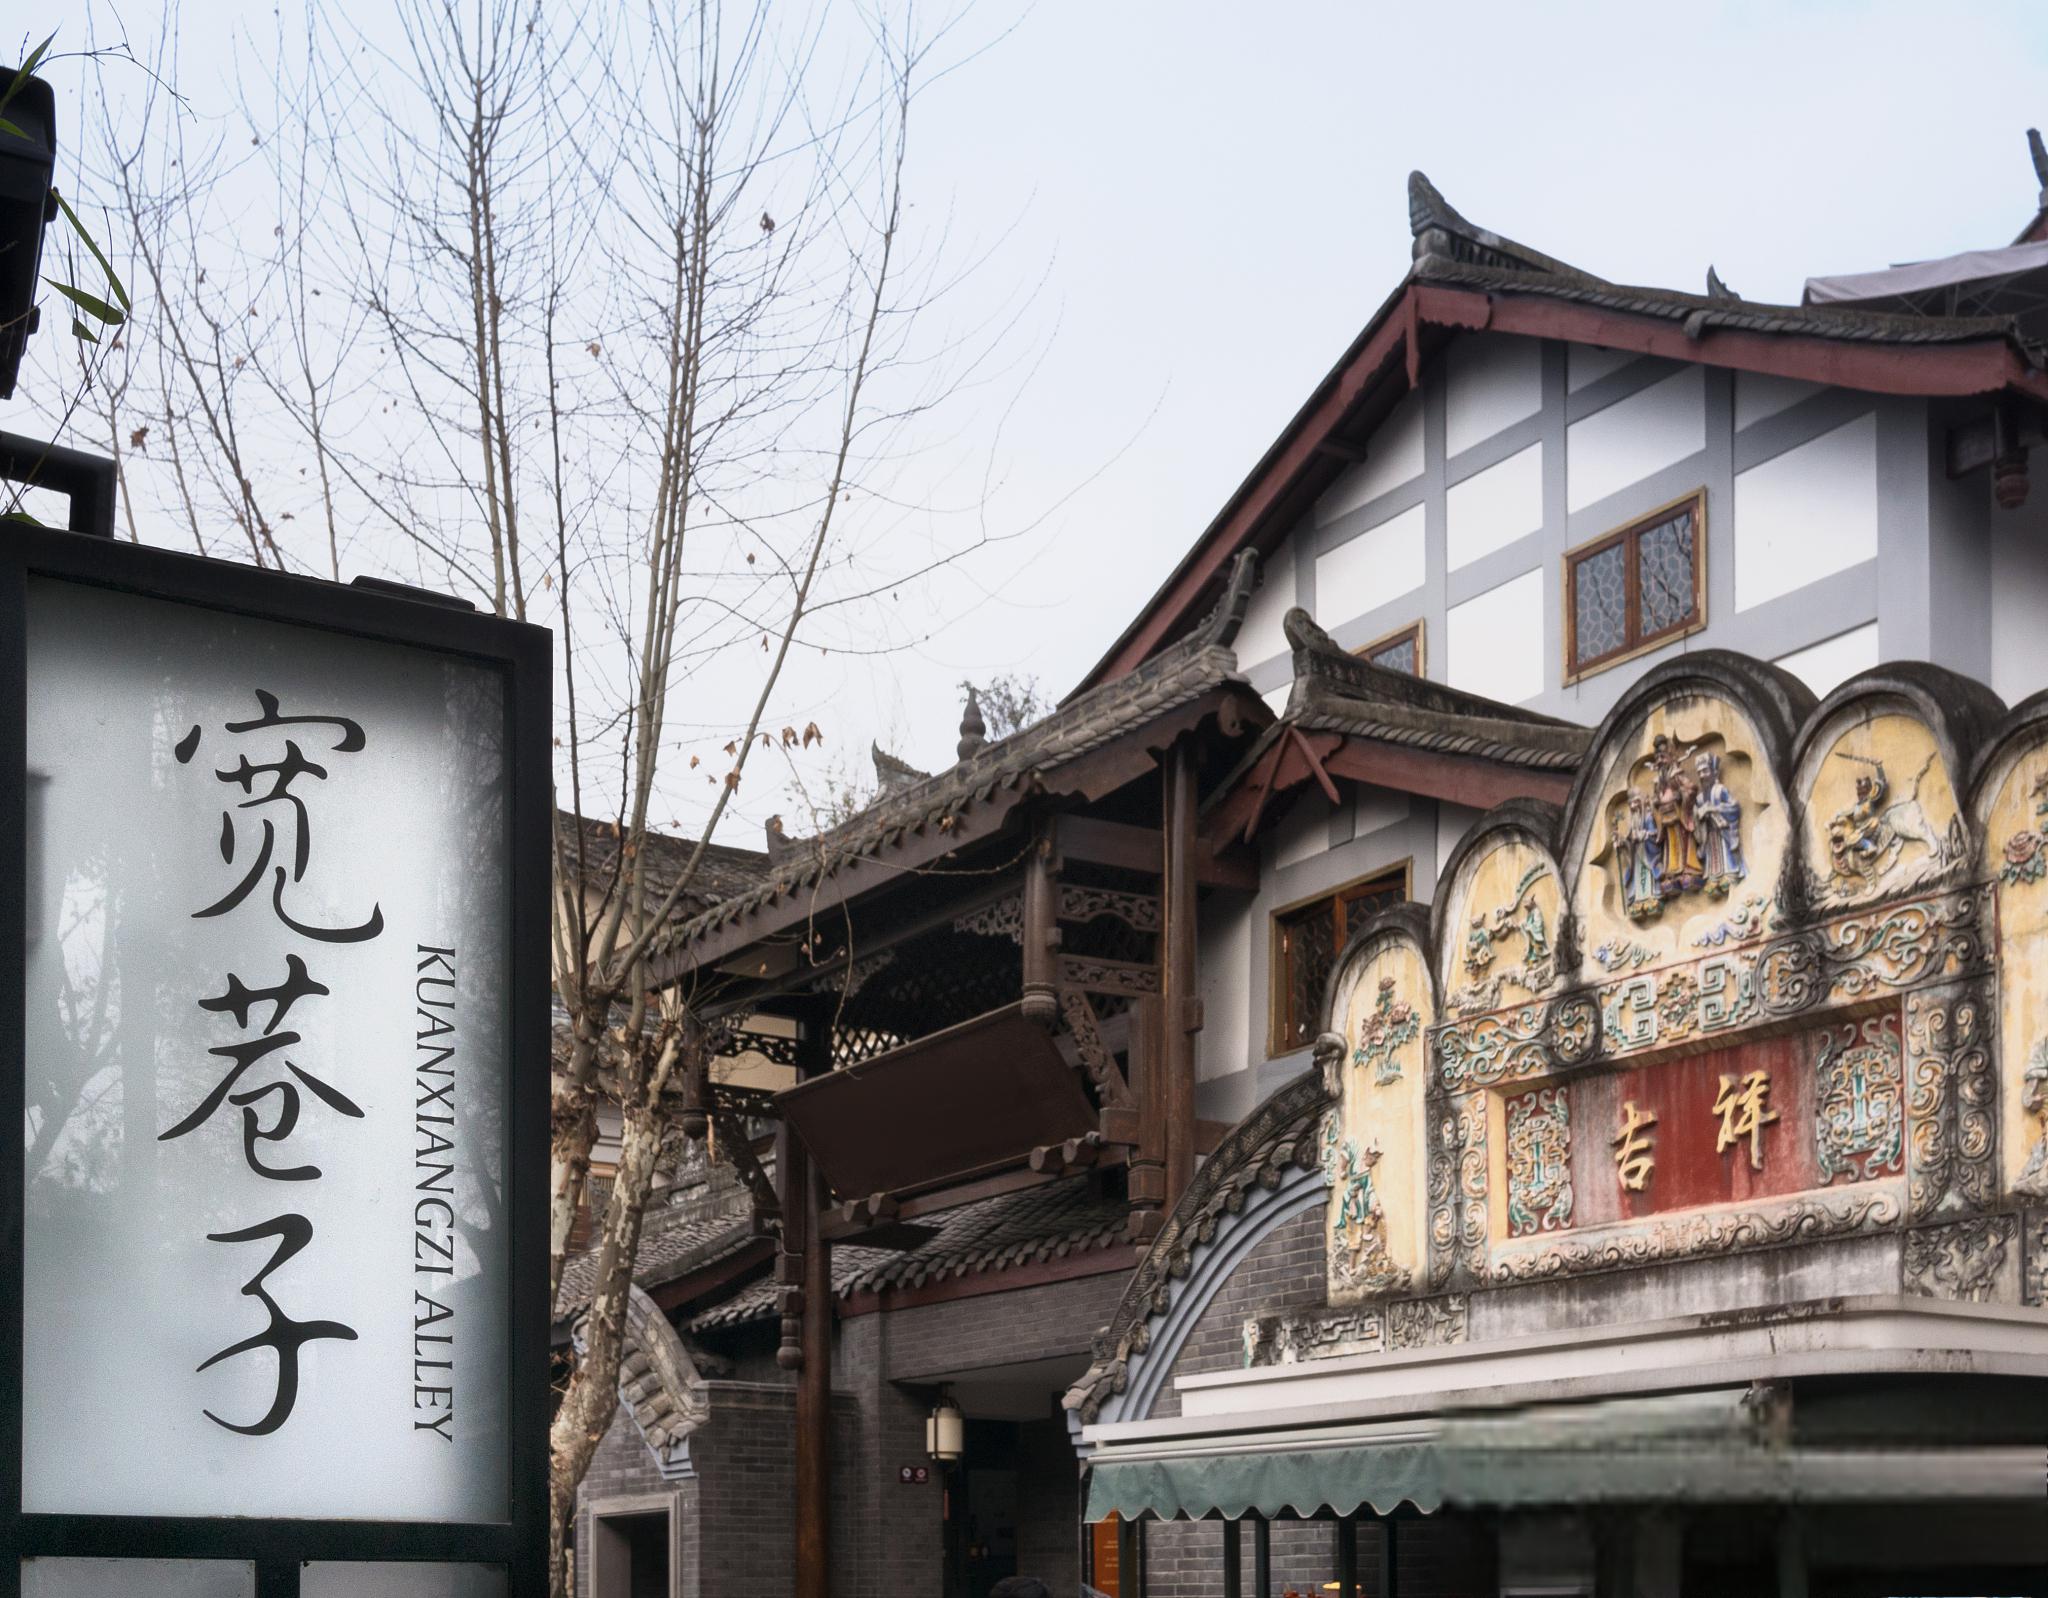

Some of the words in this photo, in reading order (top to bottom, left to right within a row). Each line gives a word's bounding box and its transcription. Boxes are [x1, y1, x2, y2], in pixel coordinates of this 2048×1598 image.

[157, 688, 385, 1437] 宽巷子
[413, 943, 457, 1276] KUANXIANGZI
[1612, 1069, 1780, 1191] 吉祥
[413, 1289, 455, 1444] ALLEY
